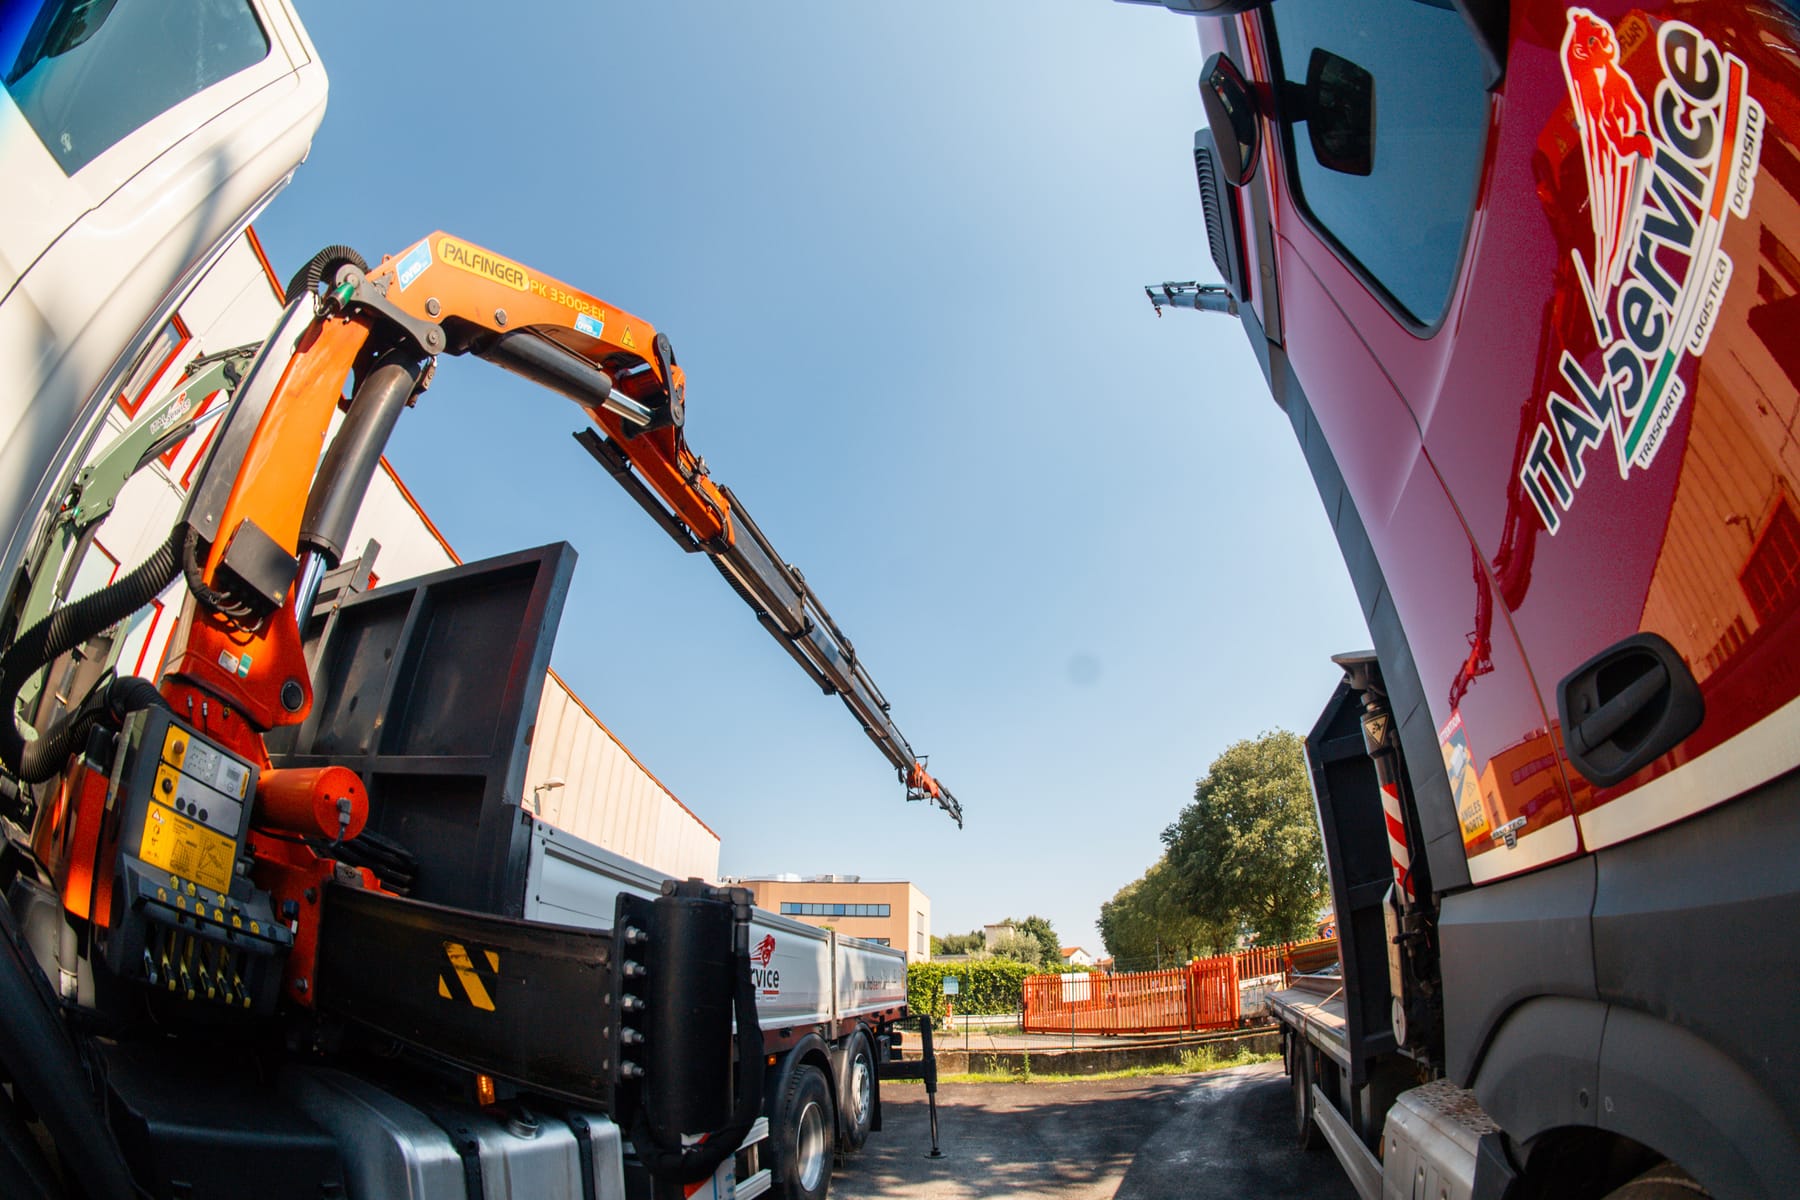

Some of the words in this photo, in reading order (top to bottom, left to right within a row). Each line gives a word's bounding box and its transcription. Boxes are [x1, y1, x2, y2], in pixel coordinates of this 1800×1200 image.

[1733, 105, 1758, 210] DEPOSITO
[444, 242, 523, 287] PALFINGER
[530, 280, 547, 297] PK
